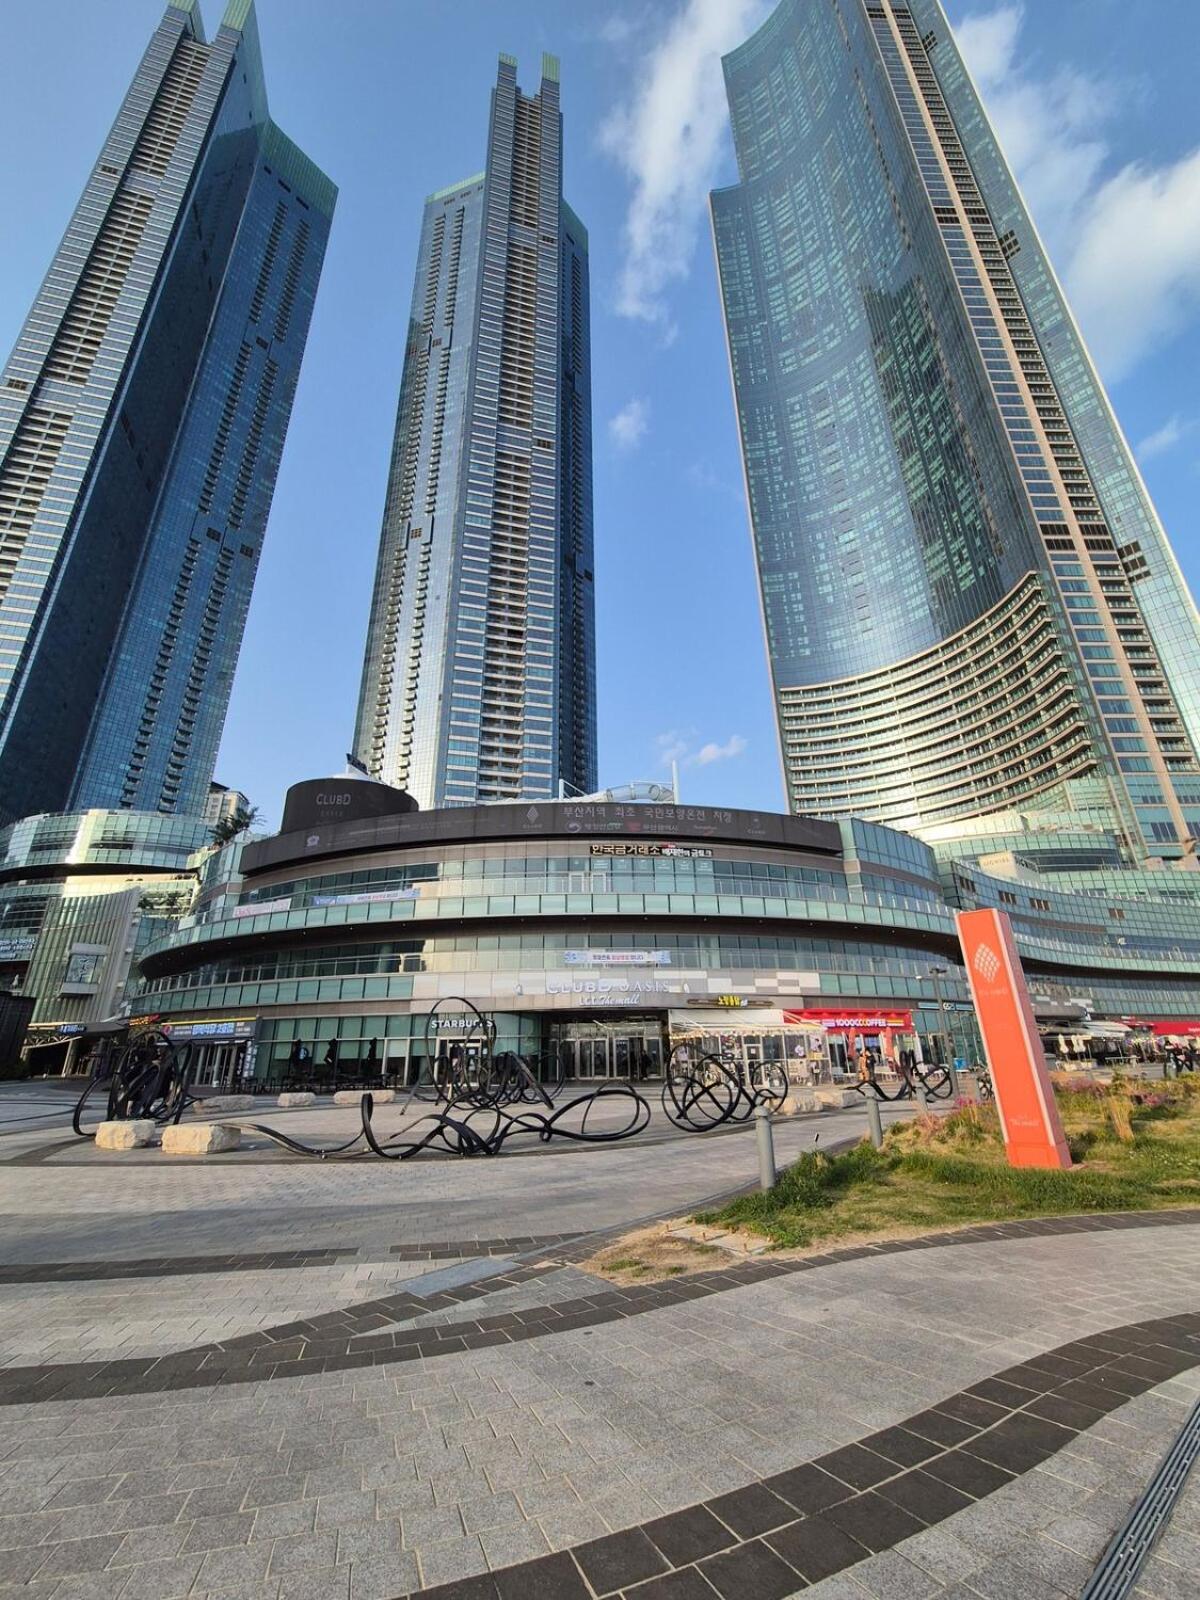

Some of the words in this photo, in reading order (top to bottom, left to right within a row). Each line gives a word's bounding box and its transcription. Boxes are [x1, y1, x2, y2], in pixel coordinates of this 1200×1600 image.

[316, 793, 351, 805] CLUBD
[563, 806, 606, 818] 부산지역
[615, 806, 636, 818] 최초
[591, 844, 661, 856] 한국금거래소
[547, 980, 612, 994] CLUBD
[431, 1019, 493, 1029] STARBUCS
